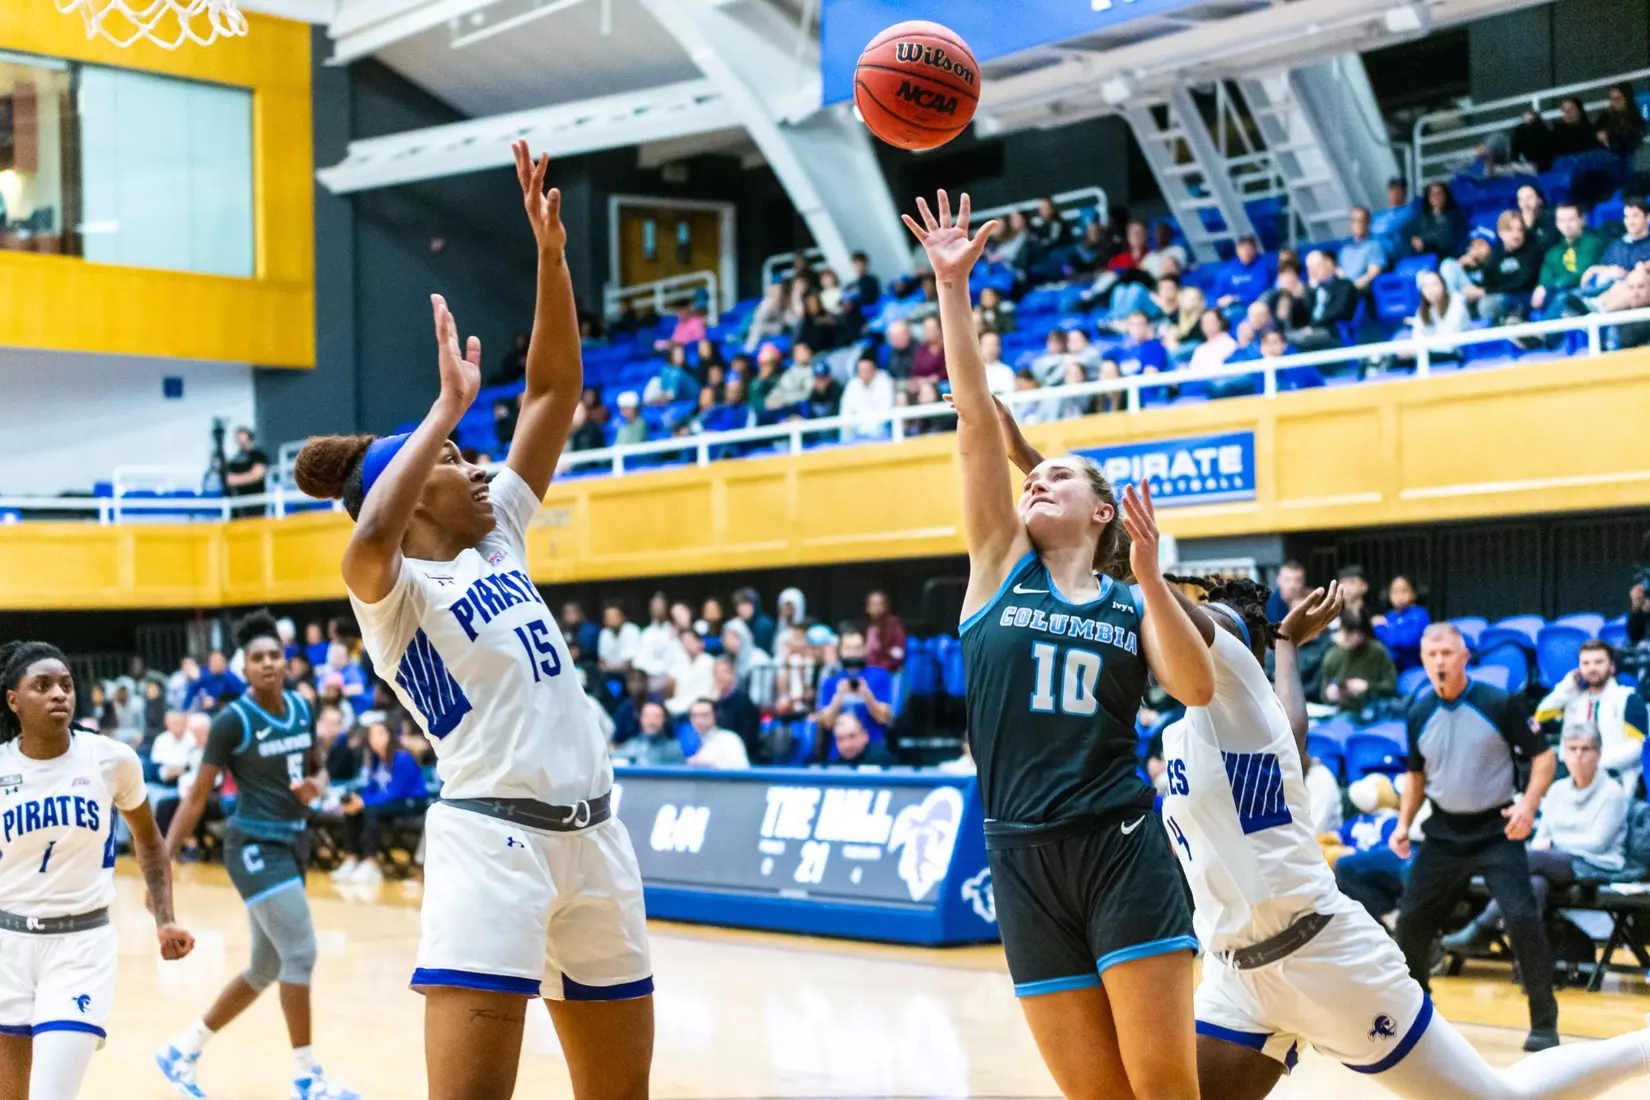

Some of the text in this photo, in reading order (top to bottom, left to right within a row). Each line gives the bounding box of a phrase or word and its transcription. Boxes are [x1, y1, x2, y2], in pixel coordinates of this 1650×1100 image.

[896, 41, 974, 86] Wilson
[896, 80, 958, 116] NCAA
[1103, 444, 1243, 482] PIRATE
[513, 619, 562, 683] 15
[1000, 606, 1138, 656] COLUMBIA
[1029, 640, 1103, 717] 10
[3, 795, 99, 843] PIRATES
[38, 840, 56, 873] 1
[794, 840, 830, 884] 21
